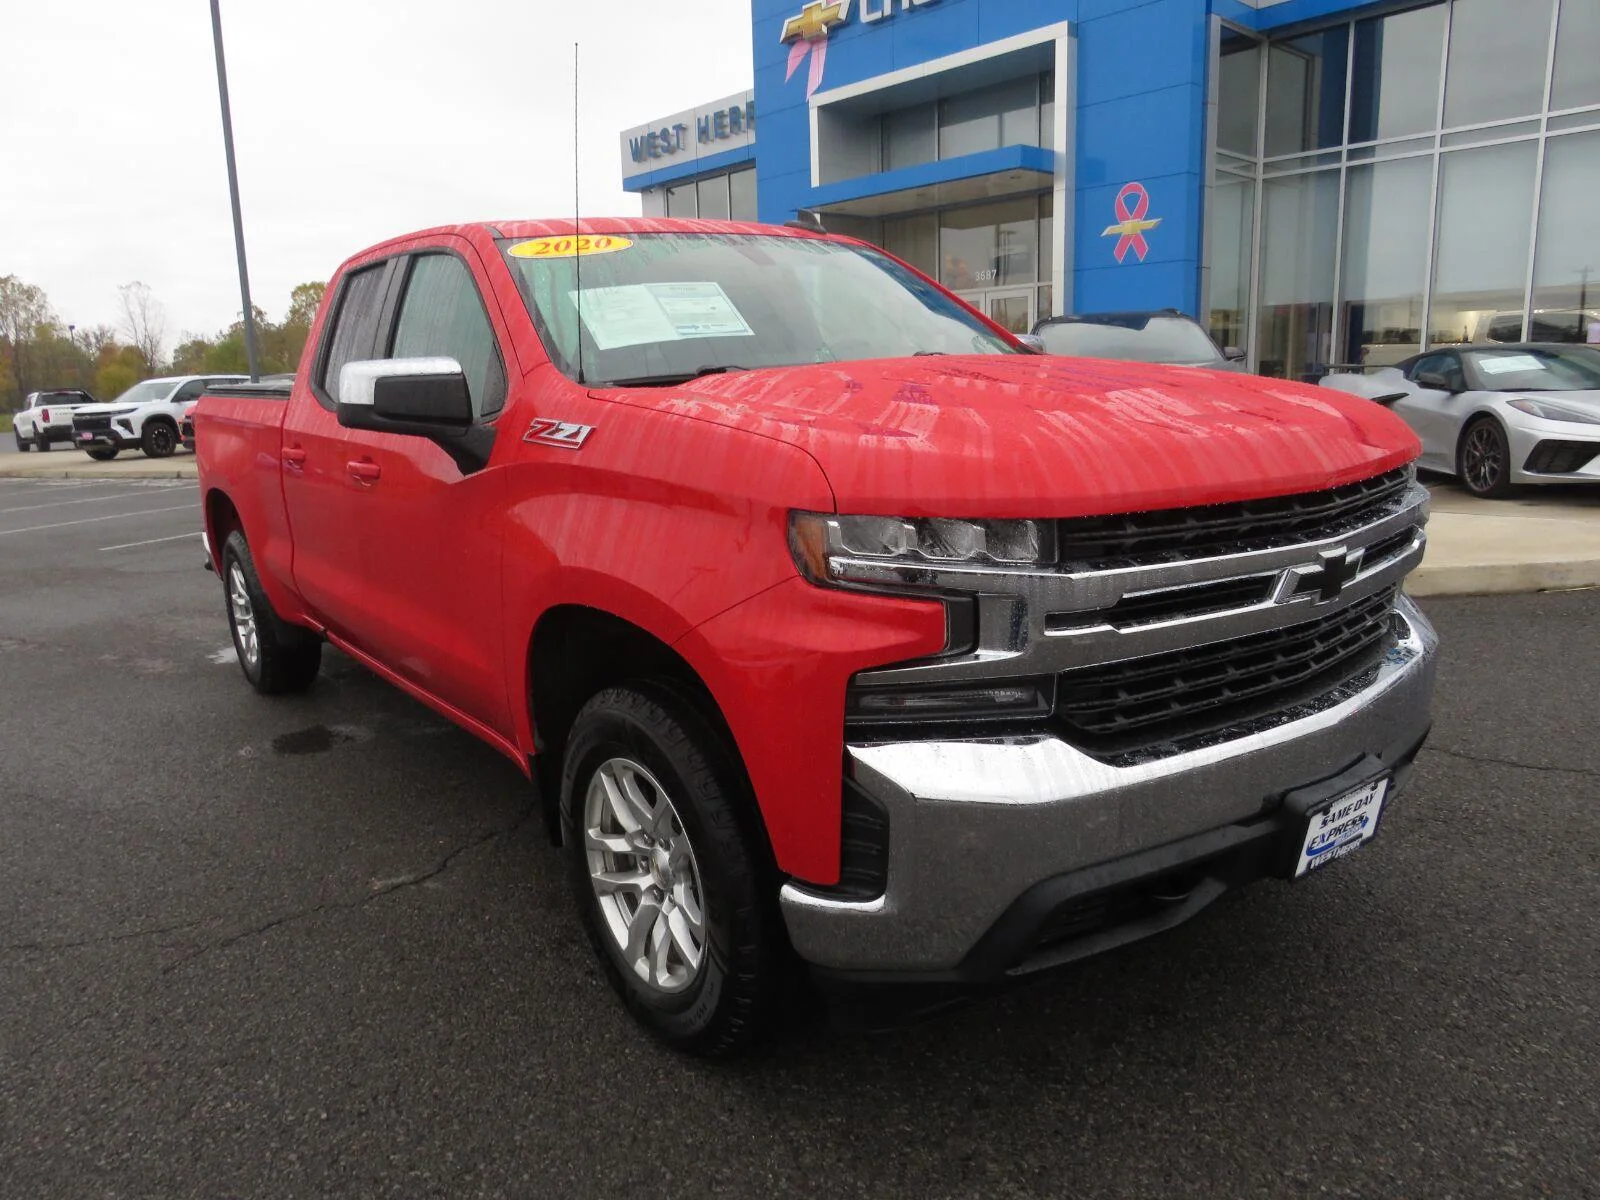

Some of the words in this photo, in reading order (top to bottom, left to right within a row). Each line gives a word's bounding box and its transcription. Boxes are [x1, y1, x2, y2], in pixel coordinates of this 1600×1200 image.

[629, 123, 687, 163] WEST
[534, 238, 612, 255] 2020
[523, 418, 593, 448] Z71
[1320, 804, 1353, 829] SAME
[1353, 791, 1377, 812] DAY
[1310, 812, 1367, 849] EXPRESS
